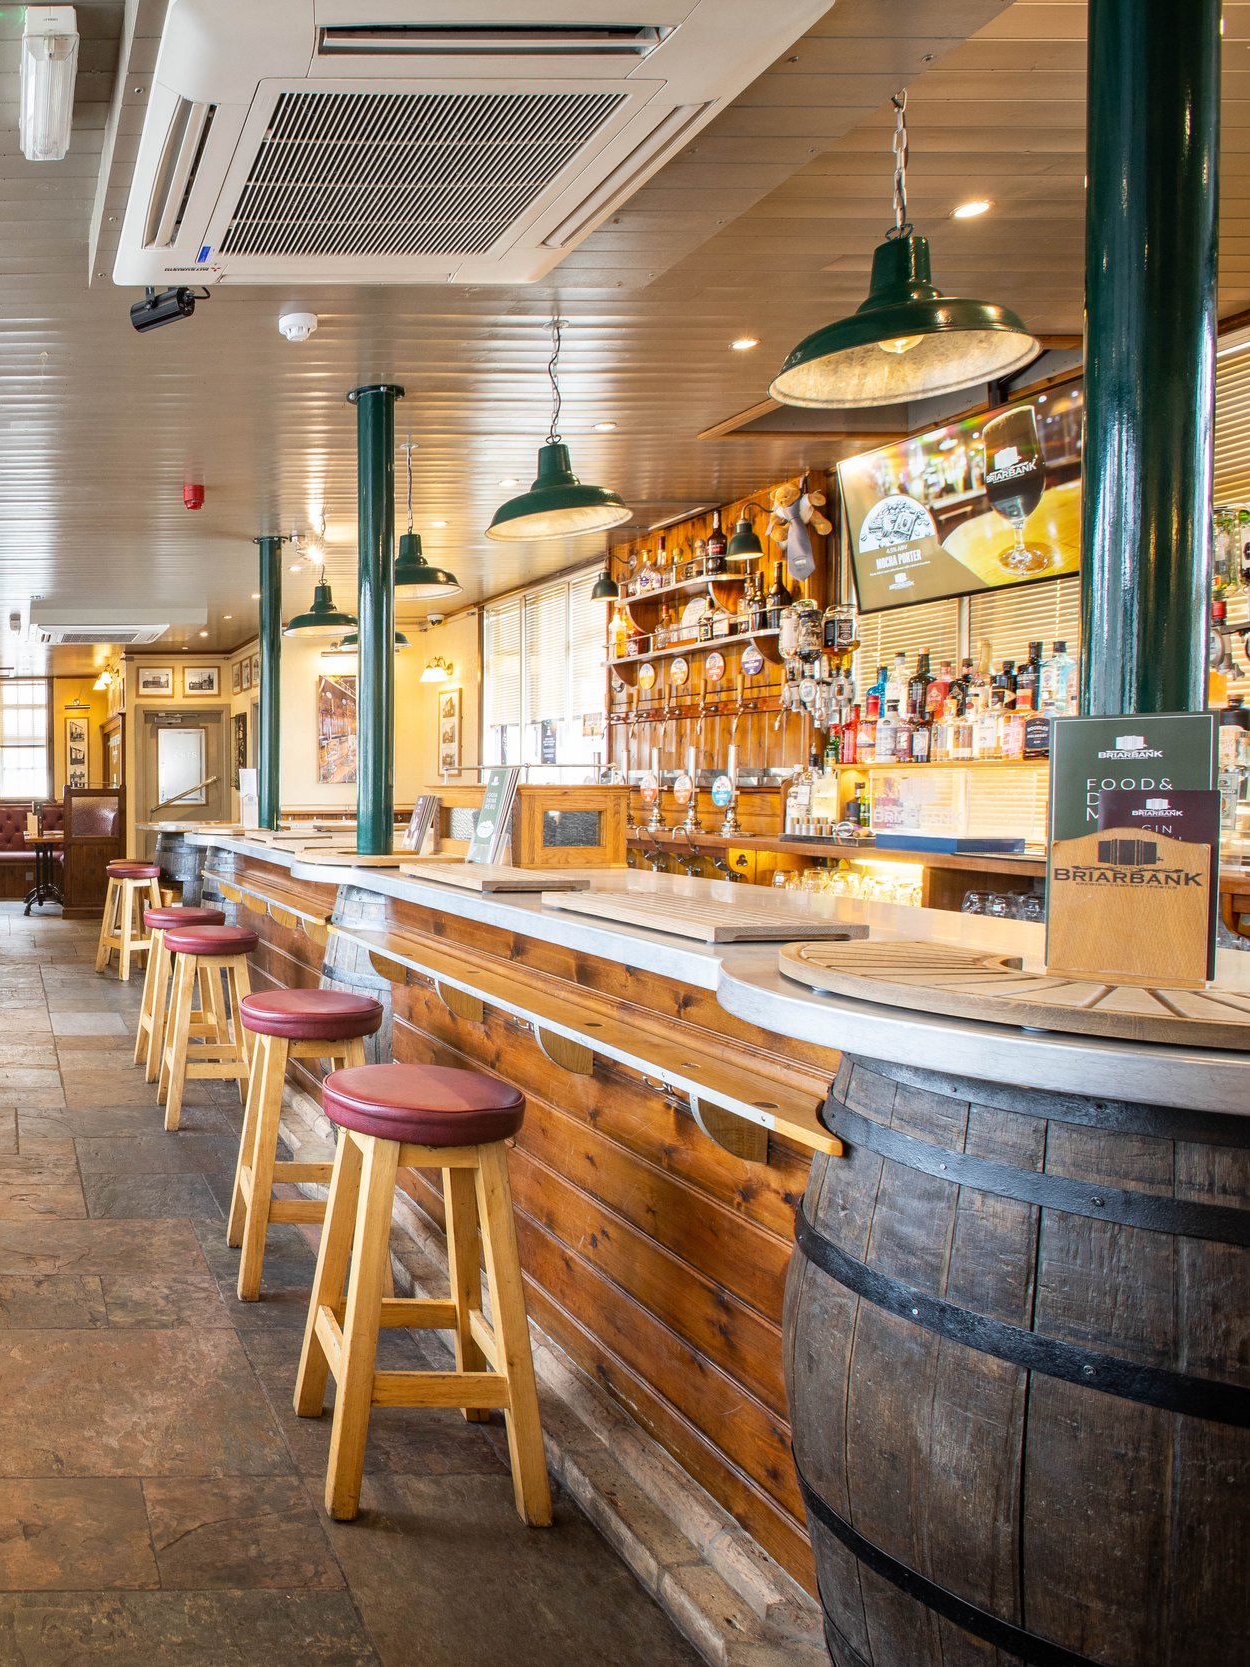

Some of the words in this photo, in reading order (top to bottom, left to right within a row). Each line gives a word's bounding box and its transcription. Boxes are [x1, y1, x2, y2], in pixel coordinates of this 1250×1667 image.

[876, 554, 898, 570] MOCHA
[898, 549, 922, 565] PORTER
[1098, 750, 1164, 759] BRIARBANK
[1142, 824, 1172, 834] GIN
[1054, 868, 1203, 886] BRIARBANK
